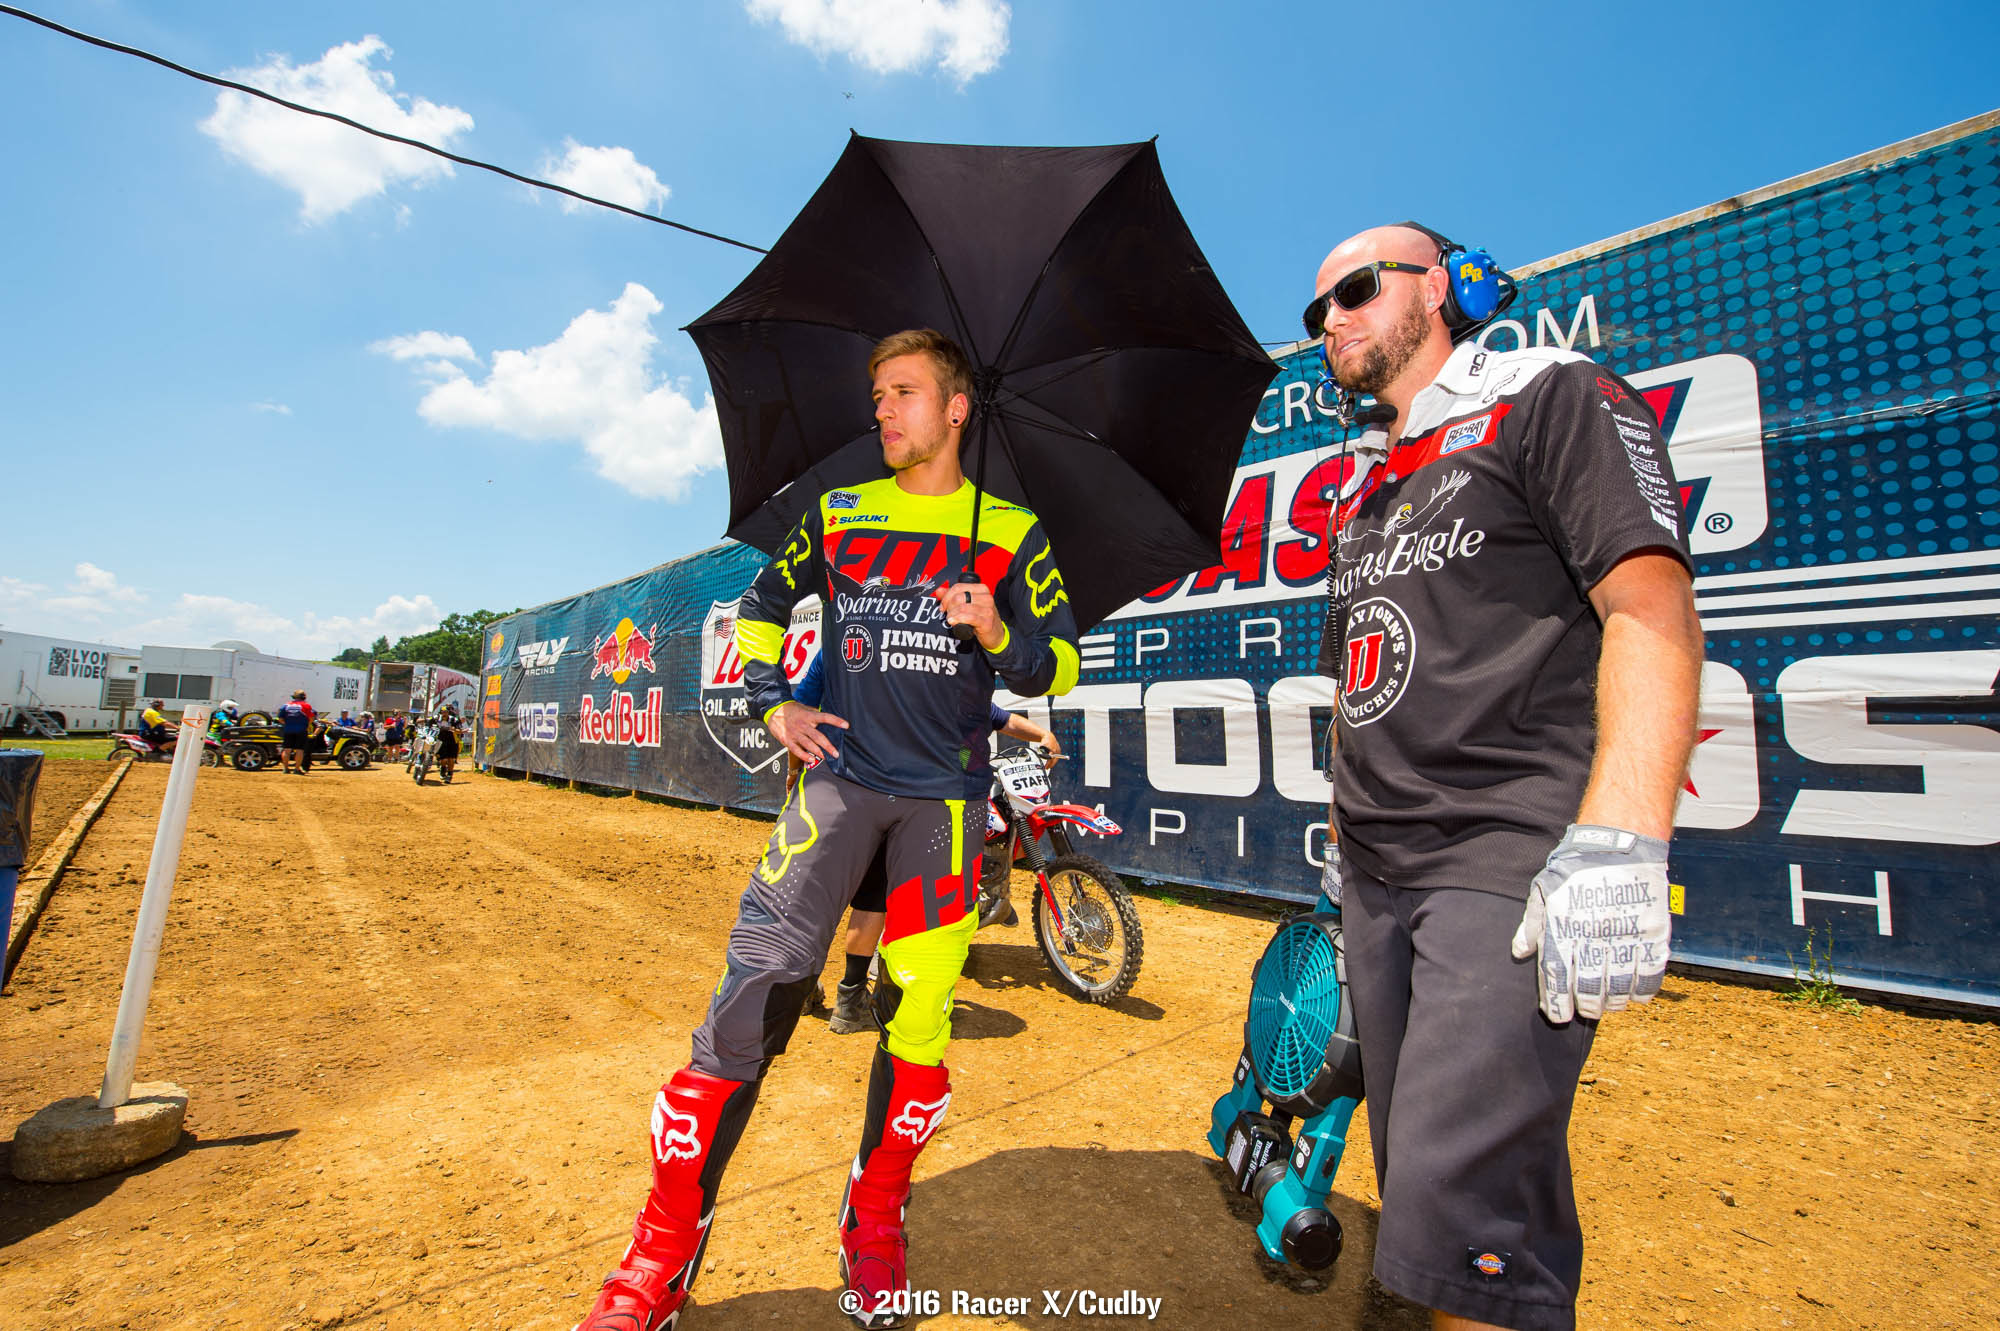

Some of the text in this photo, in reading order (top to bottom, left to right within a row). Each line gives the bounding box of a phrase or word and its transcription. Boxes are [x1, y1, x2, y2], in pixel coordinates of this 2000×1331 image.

[839, 515, 889, 524] SUZUKI
[1385, 518, 1486, 577] Eagle
[835, 528, 995, 598] FOX
[791, 611, 820, 626] MANCE
[836, 592, 912, 623] Soaring
[518, 636, 569, 668] FLY
[844, 638, 864, 660] JJ
[880, 629, 961, 654] JIMMY
[525, 666, 556, 676] RACING
[880, 651, 959, 676] JOHN'S
[1345, 631, 1384, 696] JJ
[580, 687, 663, 747] Red Bull
[705, 697, 749, 716] OIL PR
[739, 727, 769, 748] INC.
